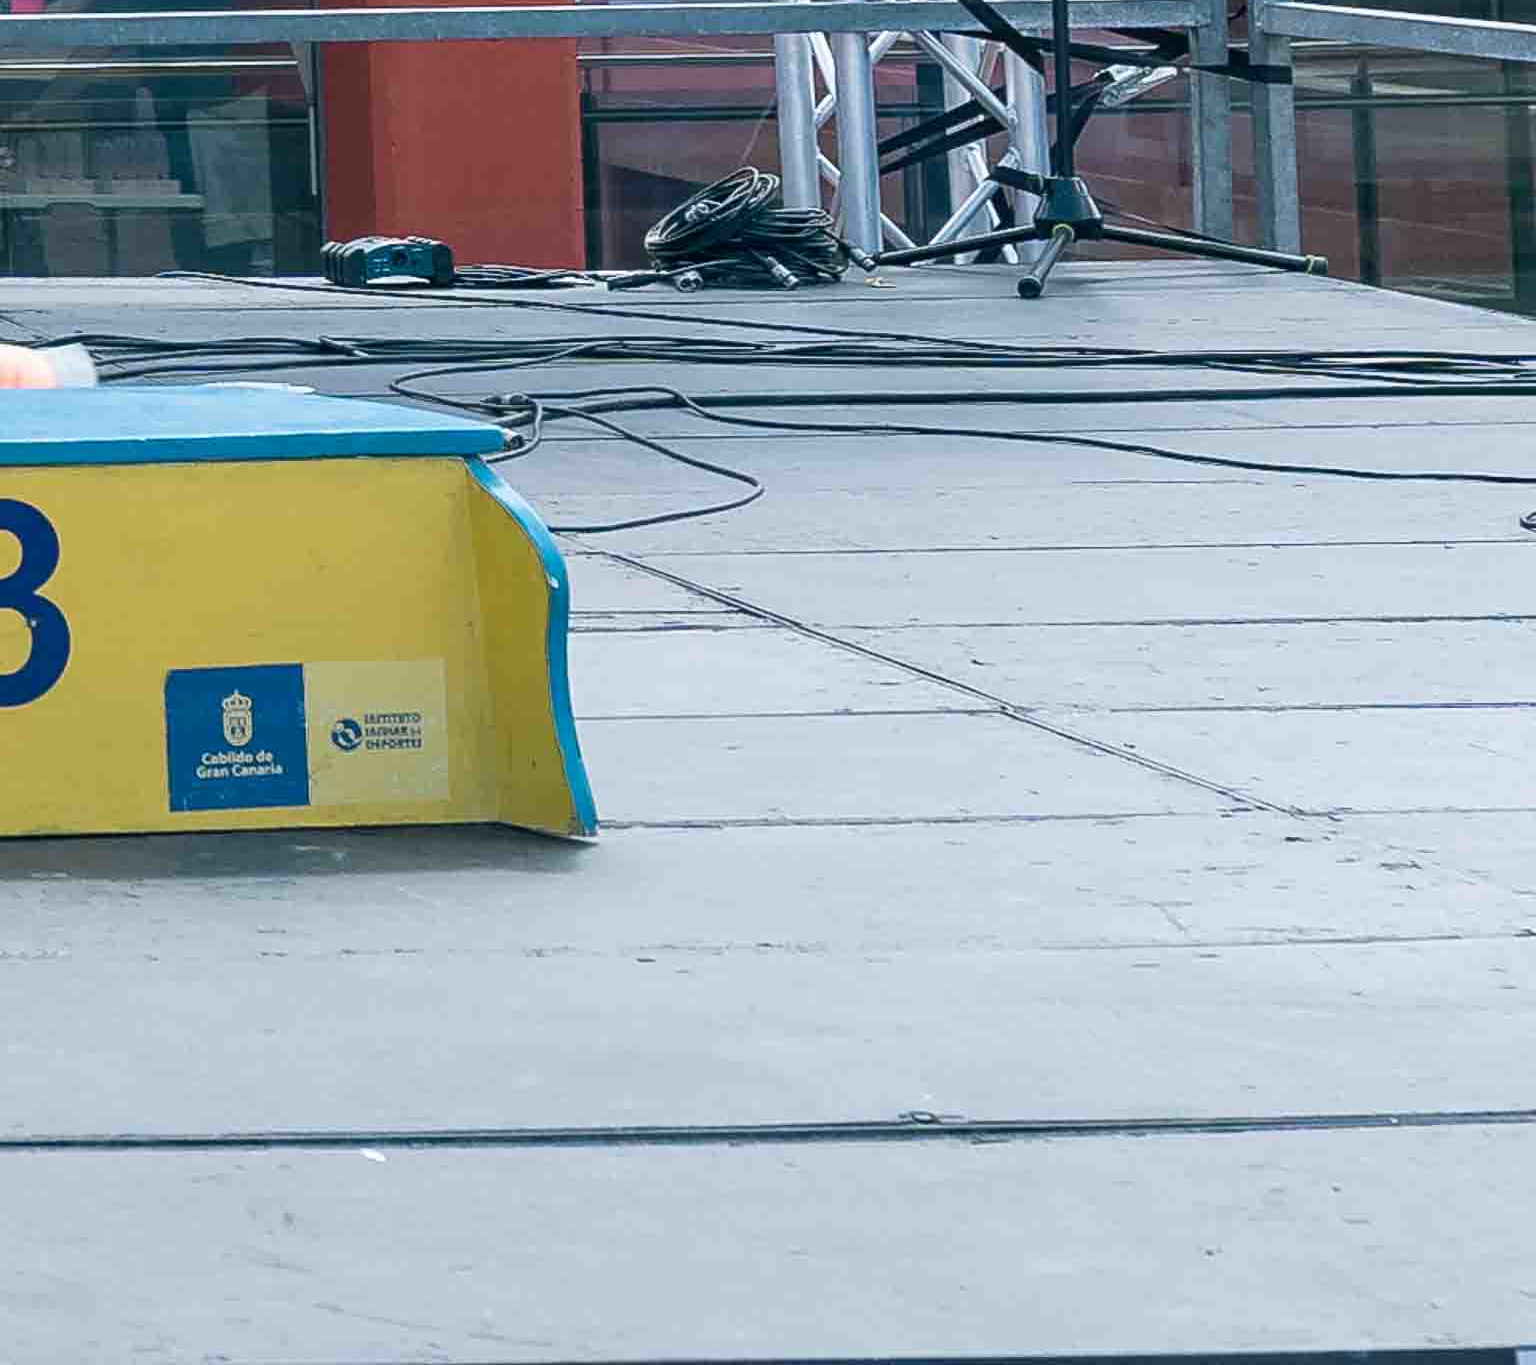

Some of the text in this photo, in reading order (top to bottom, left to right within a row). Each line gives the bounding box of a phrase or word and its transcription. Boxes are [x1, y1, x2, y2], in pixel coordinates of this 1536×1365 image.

[201, 749, 273, 766] Cabildo de
[196, 763, 283, 779] Gran Canaria
